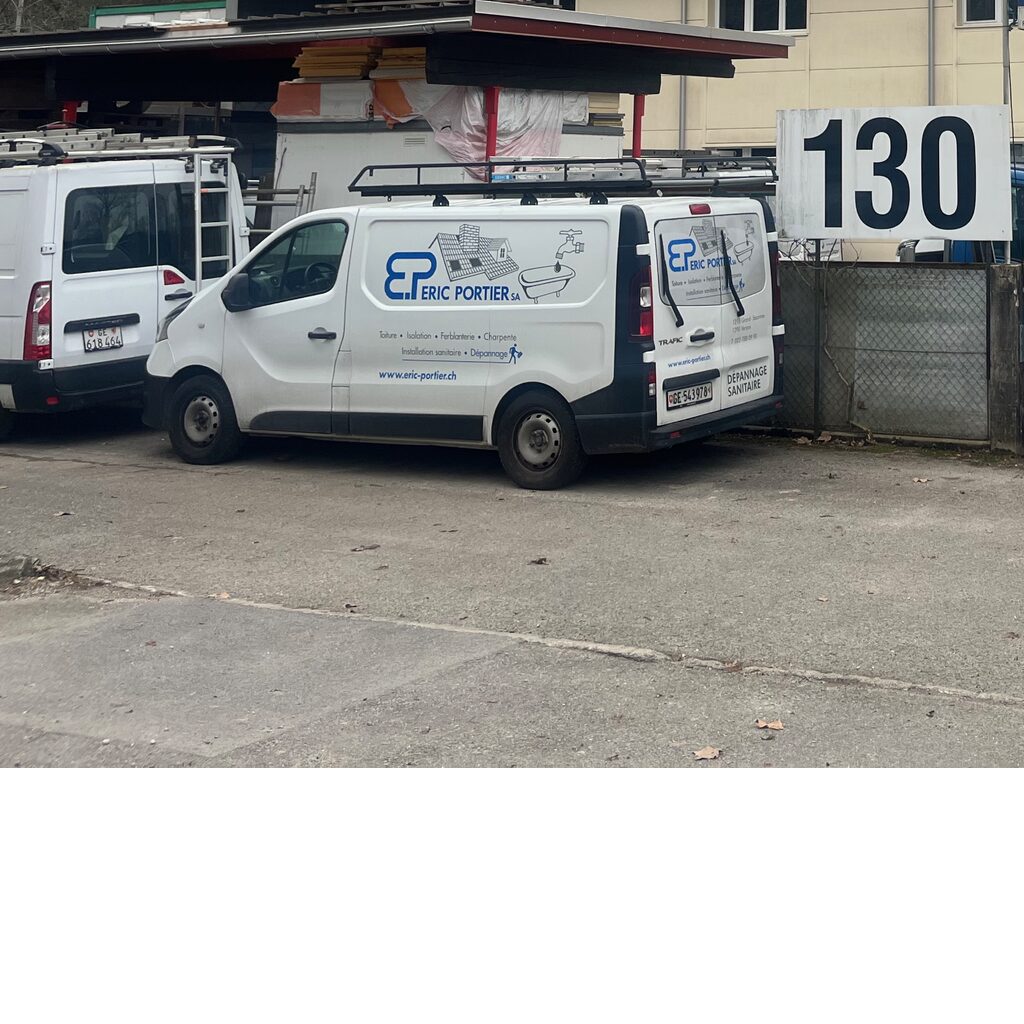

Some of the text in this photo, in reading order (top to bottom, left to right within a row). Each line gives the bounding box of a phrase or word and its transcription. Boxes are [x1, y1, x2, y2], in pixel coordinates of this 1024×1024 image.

[804, 116, 976, 230] 130
[690, 260, 705, 270] ERIC
[422, 286, 520, 301] ERIC PORTIER SA
[98, 328, 107, 336] GE
[379, 330, 517, 343] Toiture Isolation Ferblanterie Charpente
[87, 336, 120, 349] 618 464
[658, 336, 683, 346] TRAFIC
[402, 347, 433, 356] Installation
[470, 348, 508, 360] Dépannage
[379, 370, 457, 381] www.eric-portier.ch
[728, 365, 767, 384] DÉPANNAGE
[728, 379, 760, 396] SANITAIRE
